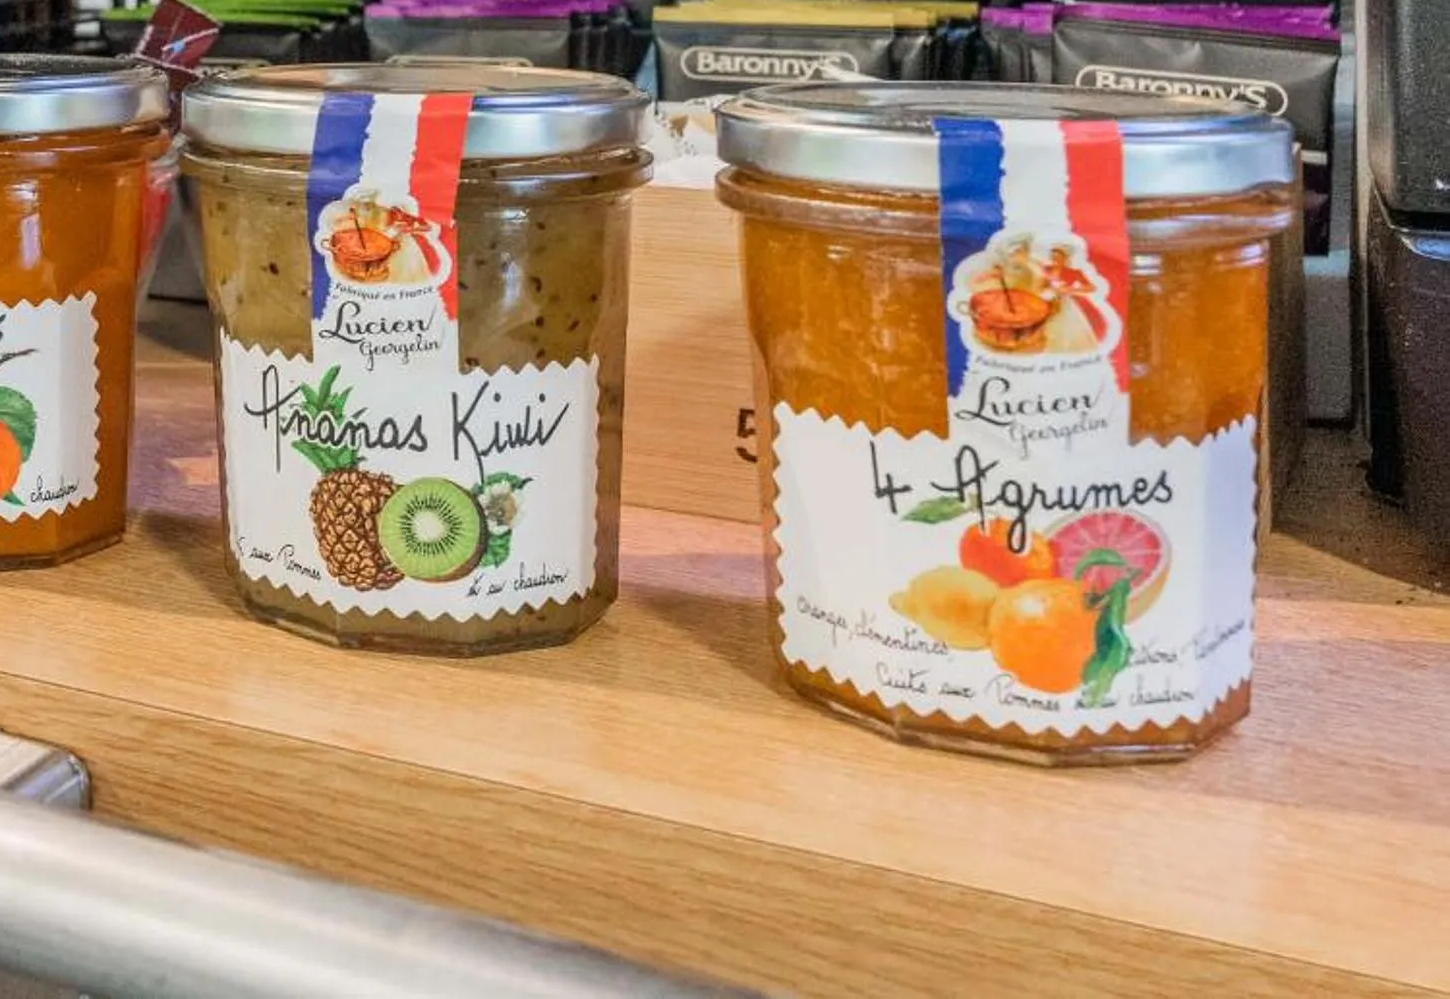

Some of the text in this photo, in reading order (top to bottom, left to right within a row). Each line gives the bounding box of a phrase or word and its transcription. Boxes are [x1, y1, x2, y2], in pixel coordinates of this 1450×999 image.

[318, 300, 437, 344] Lucien
[358, 333, 445, 372] Georgelin
[244, 364, 569, 485] Ananas Kiwi
[954, 375, 1105, 426] Lucien
[1009, 410, 1114, 461] Georgelin
[869, 440, 1174, 554] 4 Agrumes
